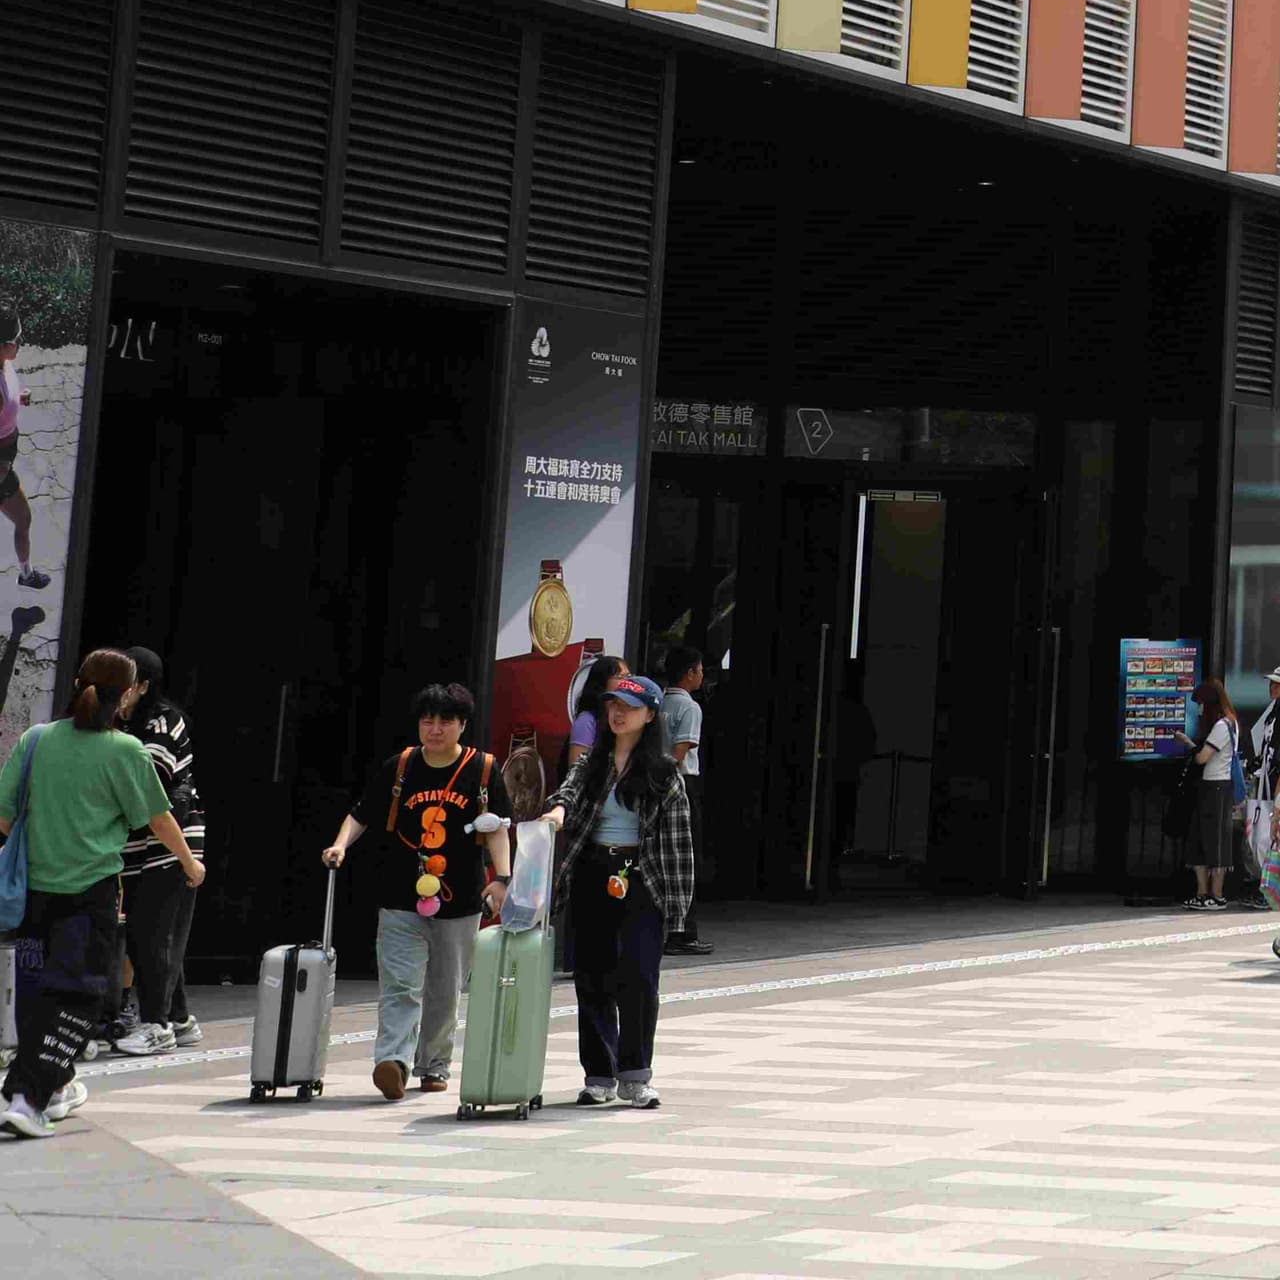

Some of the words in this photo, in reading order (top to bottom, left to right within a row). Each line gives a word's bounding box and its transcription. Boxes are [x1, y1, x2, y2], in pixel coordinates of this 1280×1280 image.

[591, 351, 609, 361] CHOW
[811, 421, 823, 438] 2
[677, 431, 709, 446] TAK
[713, 432, 758, 448] MALL
[524, 455, 623, 482] 周大福珠寶全力支持
[416, 789, 444, 802] STAY
